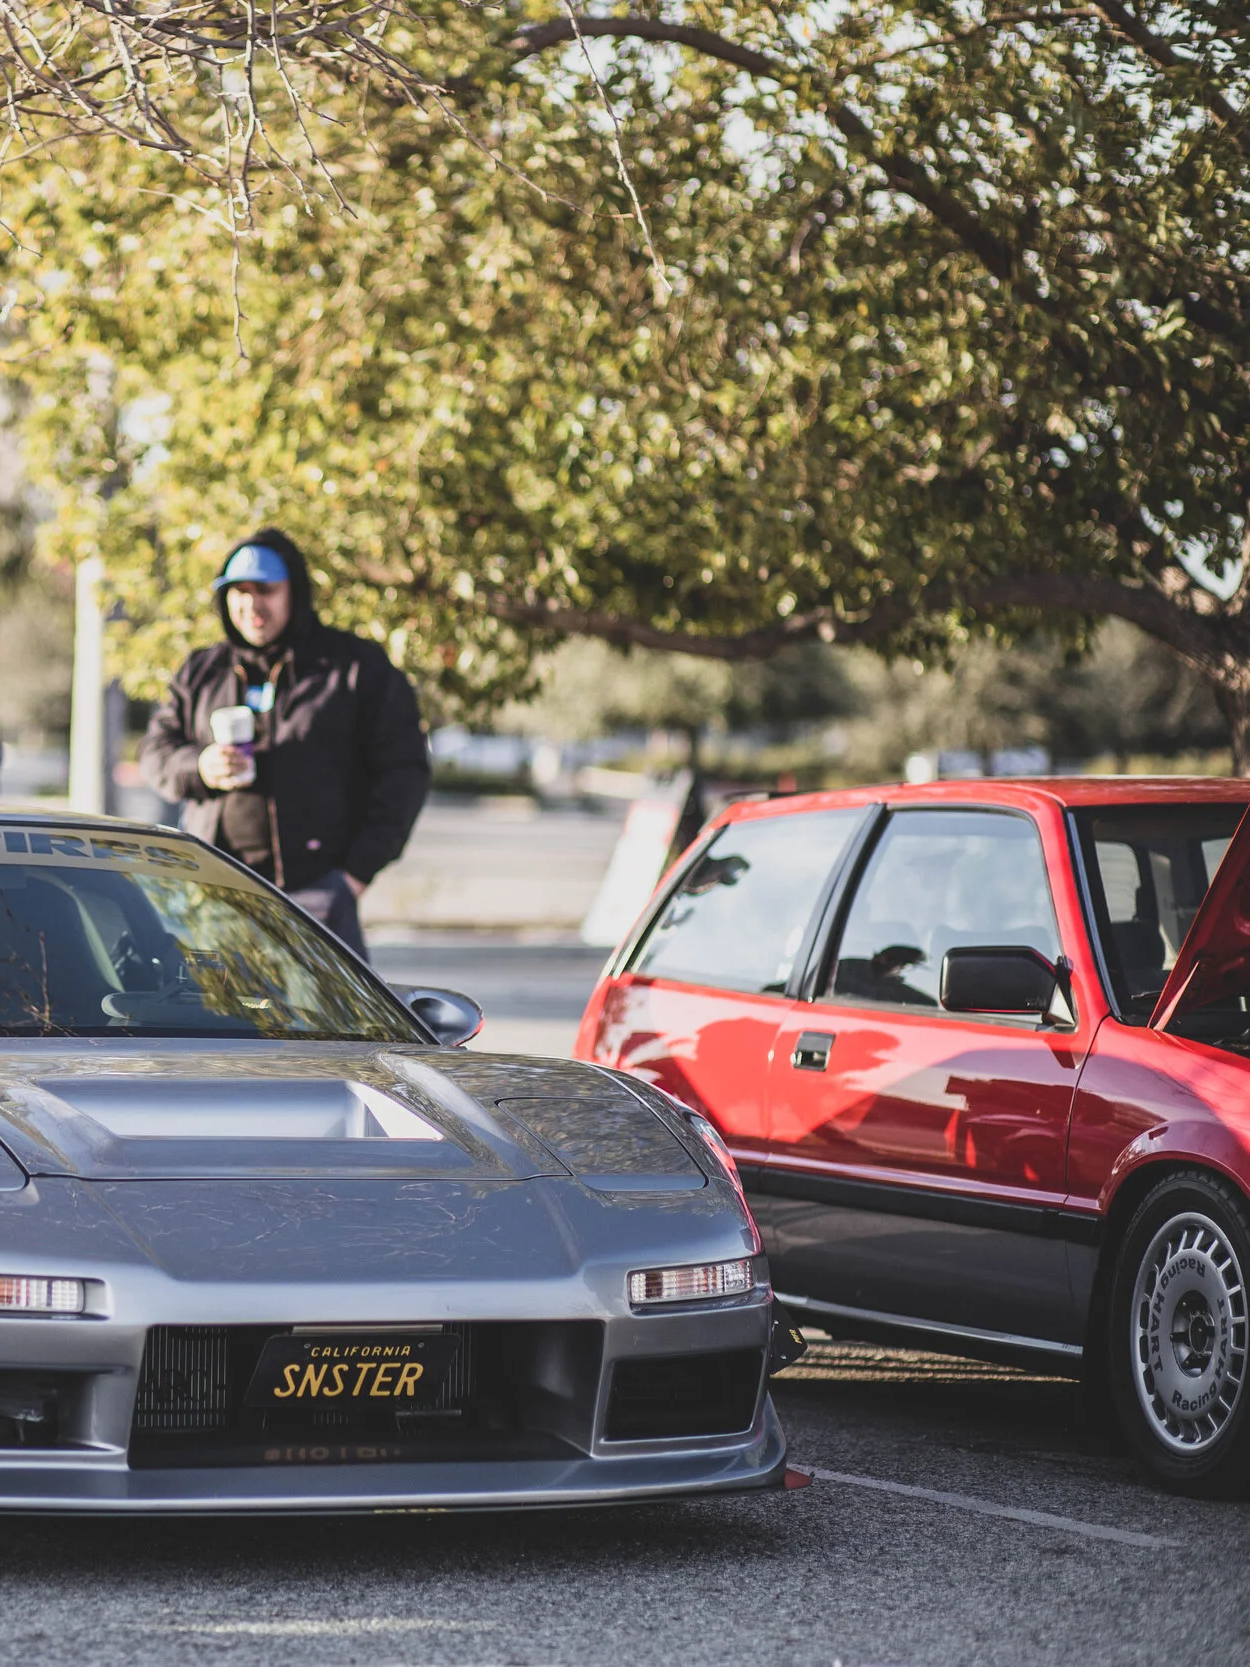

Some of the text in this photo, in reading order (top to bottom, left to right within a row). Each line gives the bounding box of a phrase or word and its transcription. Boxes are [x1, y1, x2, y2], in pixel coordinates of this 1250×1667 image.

[1150, 1257, 1206, 1372] Racing HART
[310, 1345, 412, 1358] CALIFORNIA
[273, 1362, 425, 1398] SNSTER
[1171, 1379, 1218, 1412] Racing
